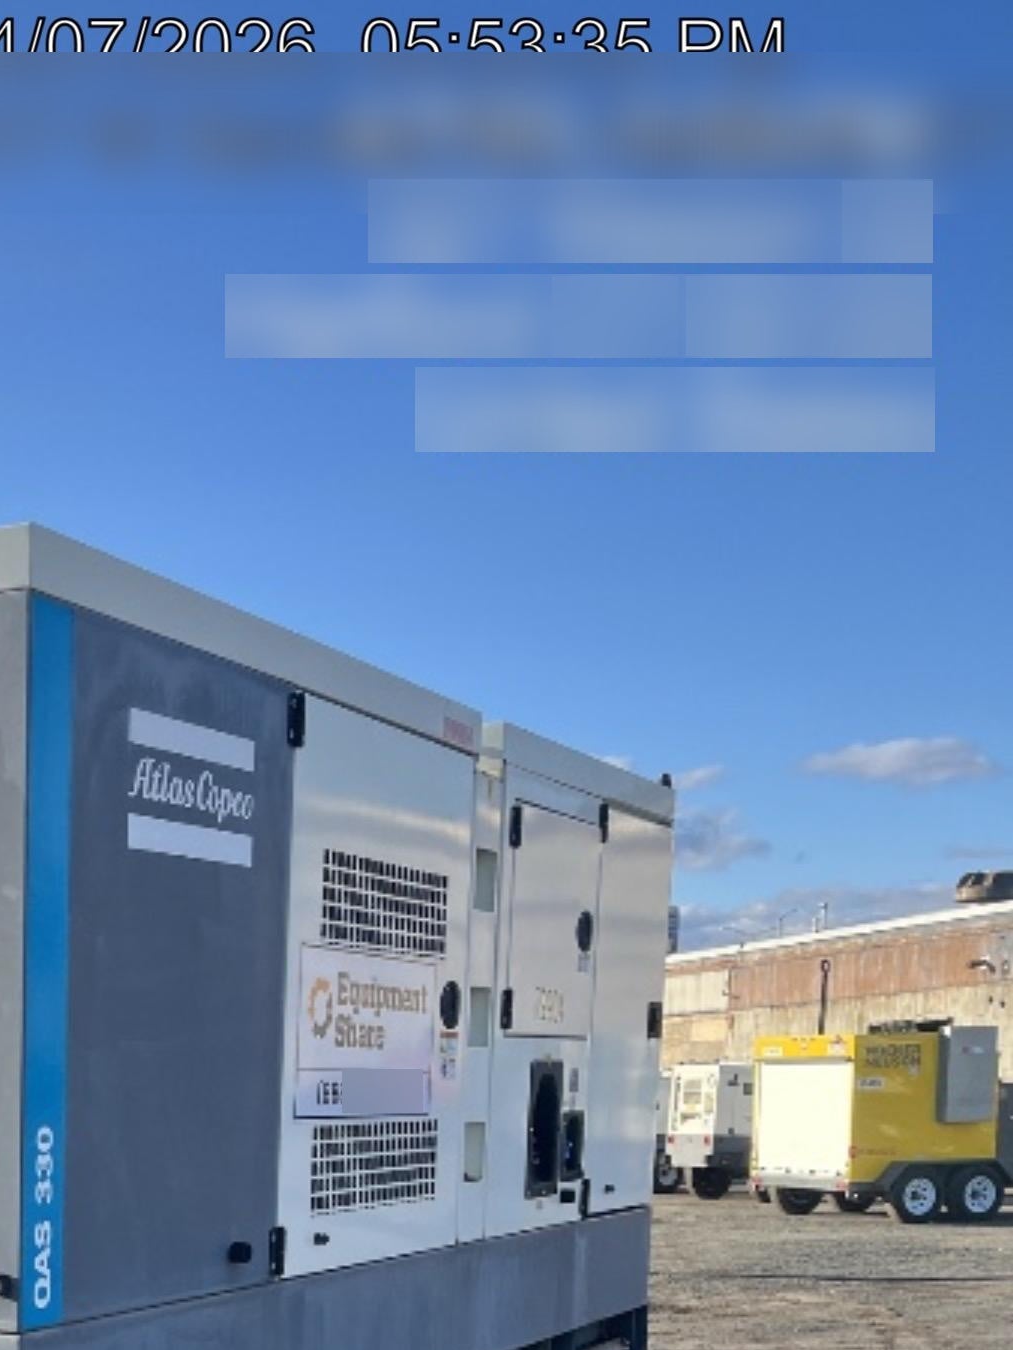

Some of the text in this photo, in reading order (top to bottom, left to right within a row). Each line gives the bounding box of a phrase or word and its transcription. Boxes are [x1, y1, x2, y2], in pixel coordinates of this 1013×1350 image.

[127, 757, 255, 823] Atlas Copco
[337, 971, 427, 1017] Equipment
[334, 1014, 385, 1049] Share
[34, 1126, 54, 1310] QAS 330
